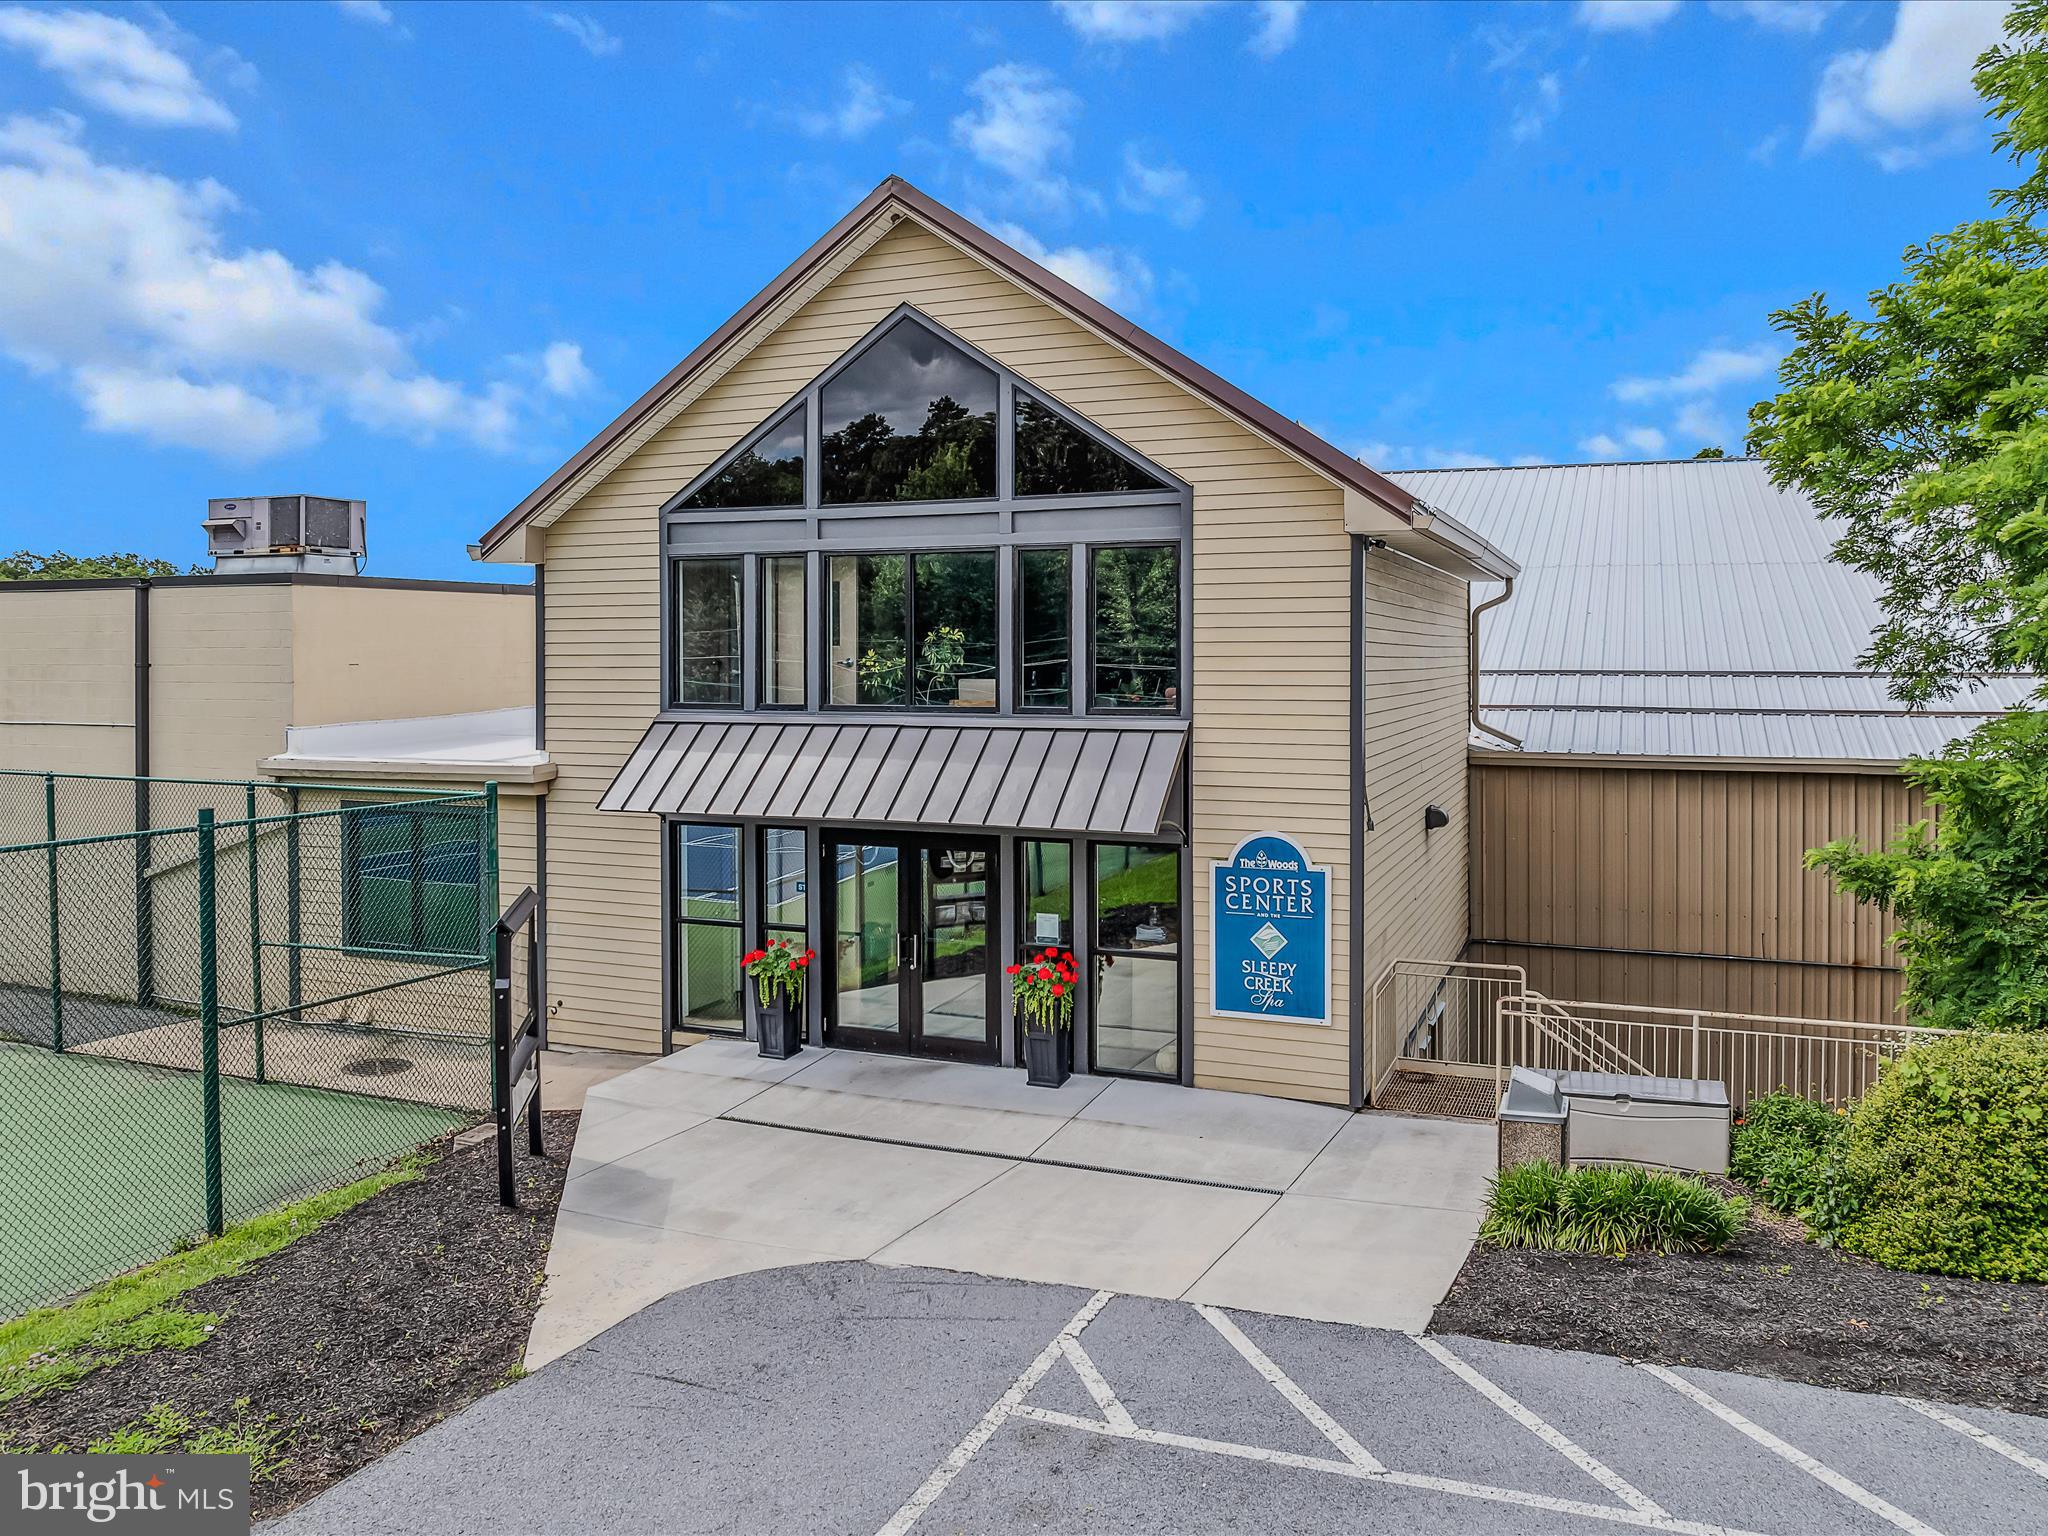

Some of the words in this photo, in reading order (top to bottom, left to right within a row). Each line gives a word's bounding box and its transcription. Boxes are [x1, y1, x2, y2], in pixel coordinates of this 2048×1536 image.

[1240, 858, 1256, 868] The
[1267, 860, 1299, 870] Woods
[1225, 875, 1312, 896] SPORTS
[1225, 893, 1315, 913] CENTER
[1241, 959, 1297, 977] SLEEPY
[1244, 976, 1293, 993] CREEK
[1250, 989, 1284, 1011] Spa
